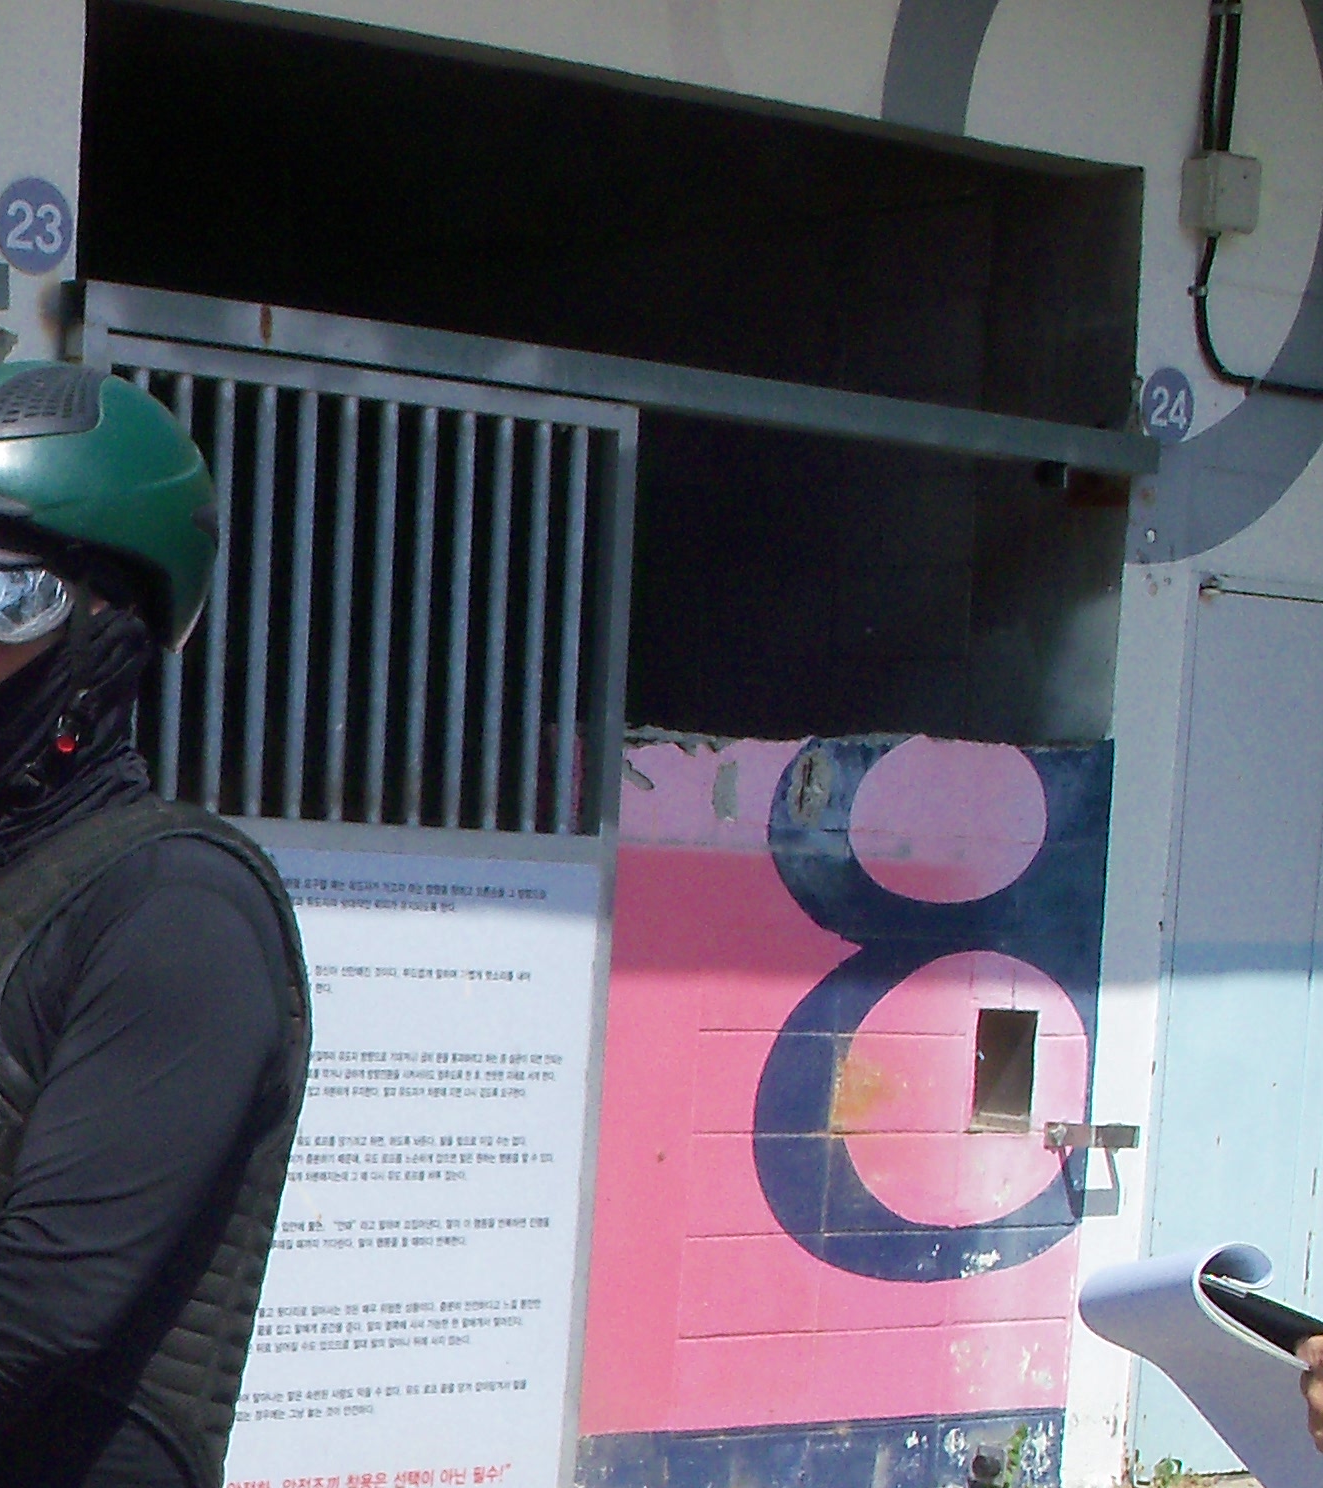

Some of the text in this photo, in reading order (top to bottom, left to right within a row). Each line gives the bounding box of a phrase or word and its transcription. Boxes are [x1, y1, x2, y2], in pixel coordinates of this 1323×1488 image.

[6, 199, 63, 254] 23
[1150, 386, 1187, 430] 24
[440, 1466, 467, 1486] 아닌
